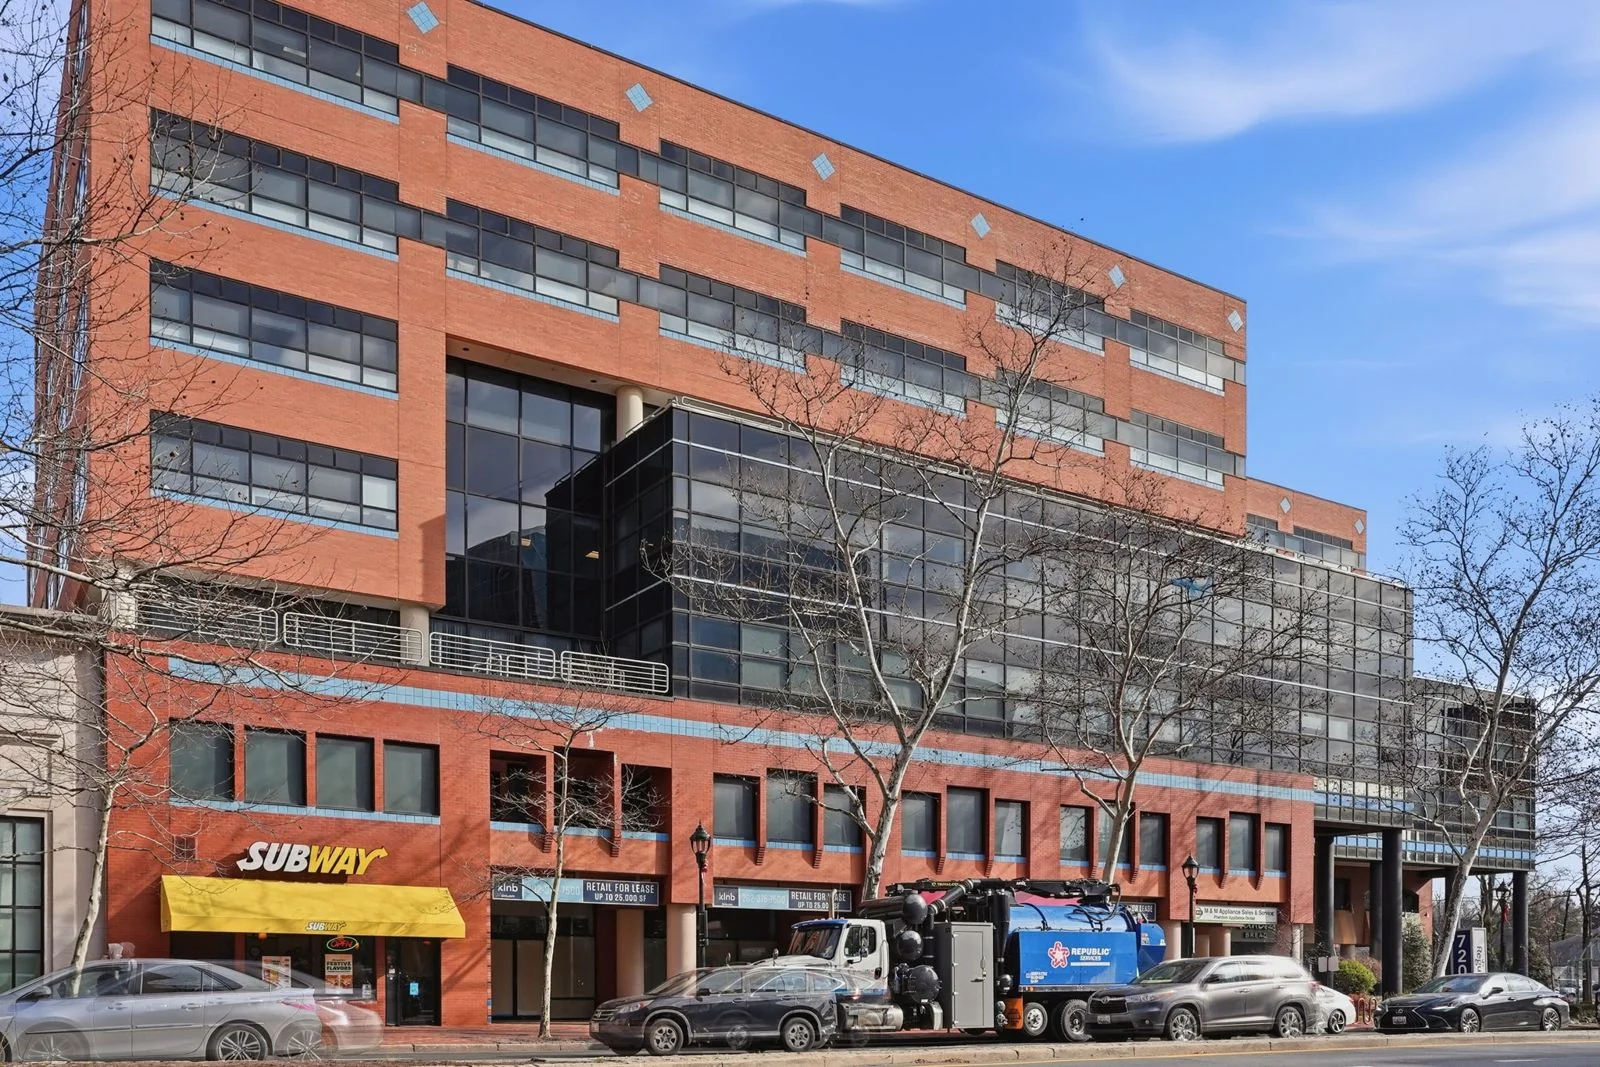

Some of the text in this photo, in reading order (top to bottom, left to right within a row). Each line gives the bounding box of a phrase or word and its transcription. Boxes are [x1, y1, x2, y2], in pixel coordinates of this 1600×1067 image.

[236, 841, 388, 875] SUBWAY
[586, 882, 655, 894] RETAIL FOR LEASE
[594, 893, 604, 901] UP
[605, 894, 613, 902] TO
[718, 892, 736, 901] klnb
[791, 891, 812, 900] RETAIL
[813, 892, 826, 901] FOR
[306, 922, 346, 931] SUBWAY
[1071, 948, 1110, 956] REPUBLIC
